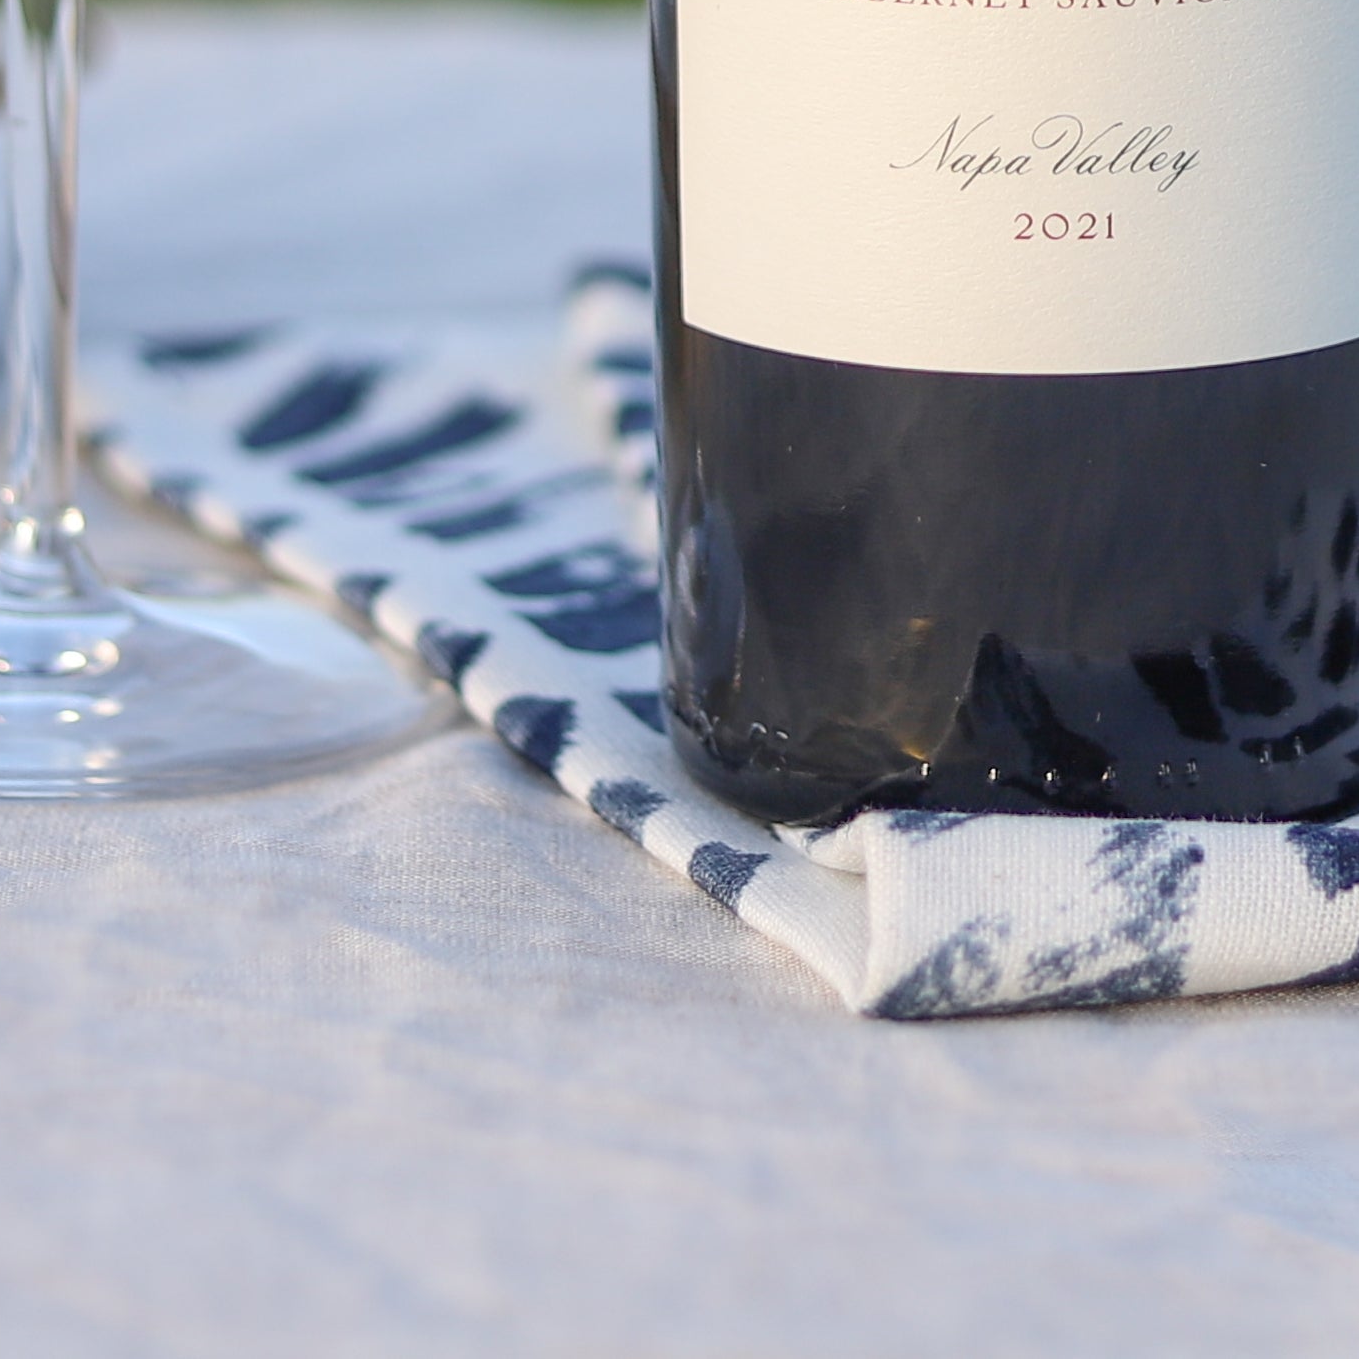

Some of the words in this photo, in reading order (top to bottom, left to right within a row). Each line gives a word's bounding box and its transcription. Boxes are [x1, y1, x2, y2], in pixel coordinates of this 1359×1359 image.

[889, 114, 1034, 191] Napa
[1032, 114, 1200, 193] Valley
[1013, 212, 1116, 240] 2021
